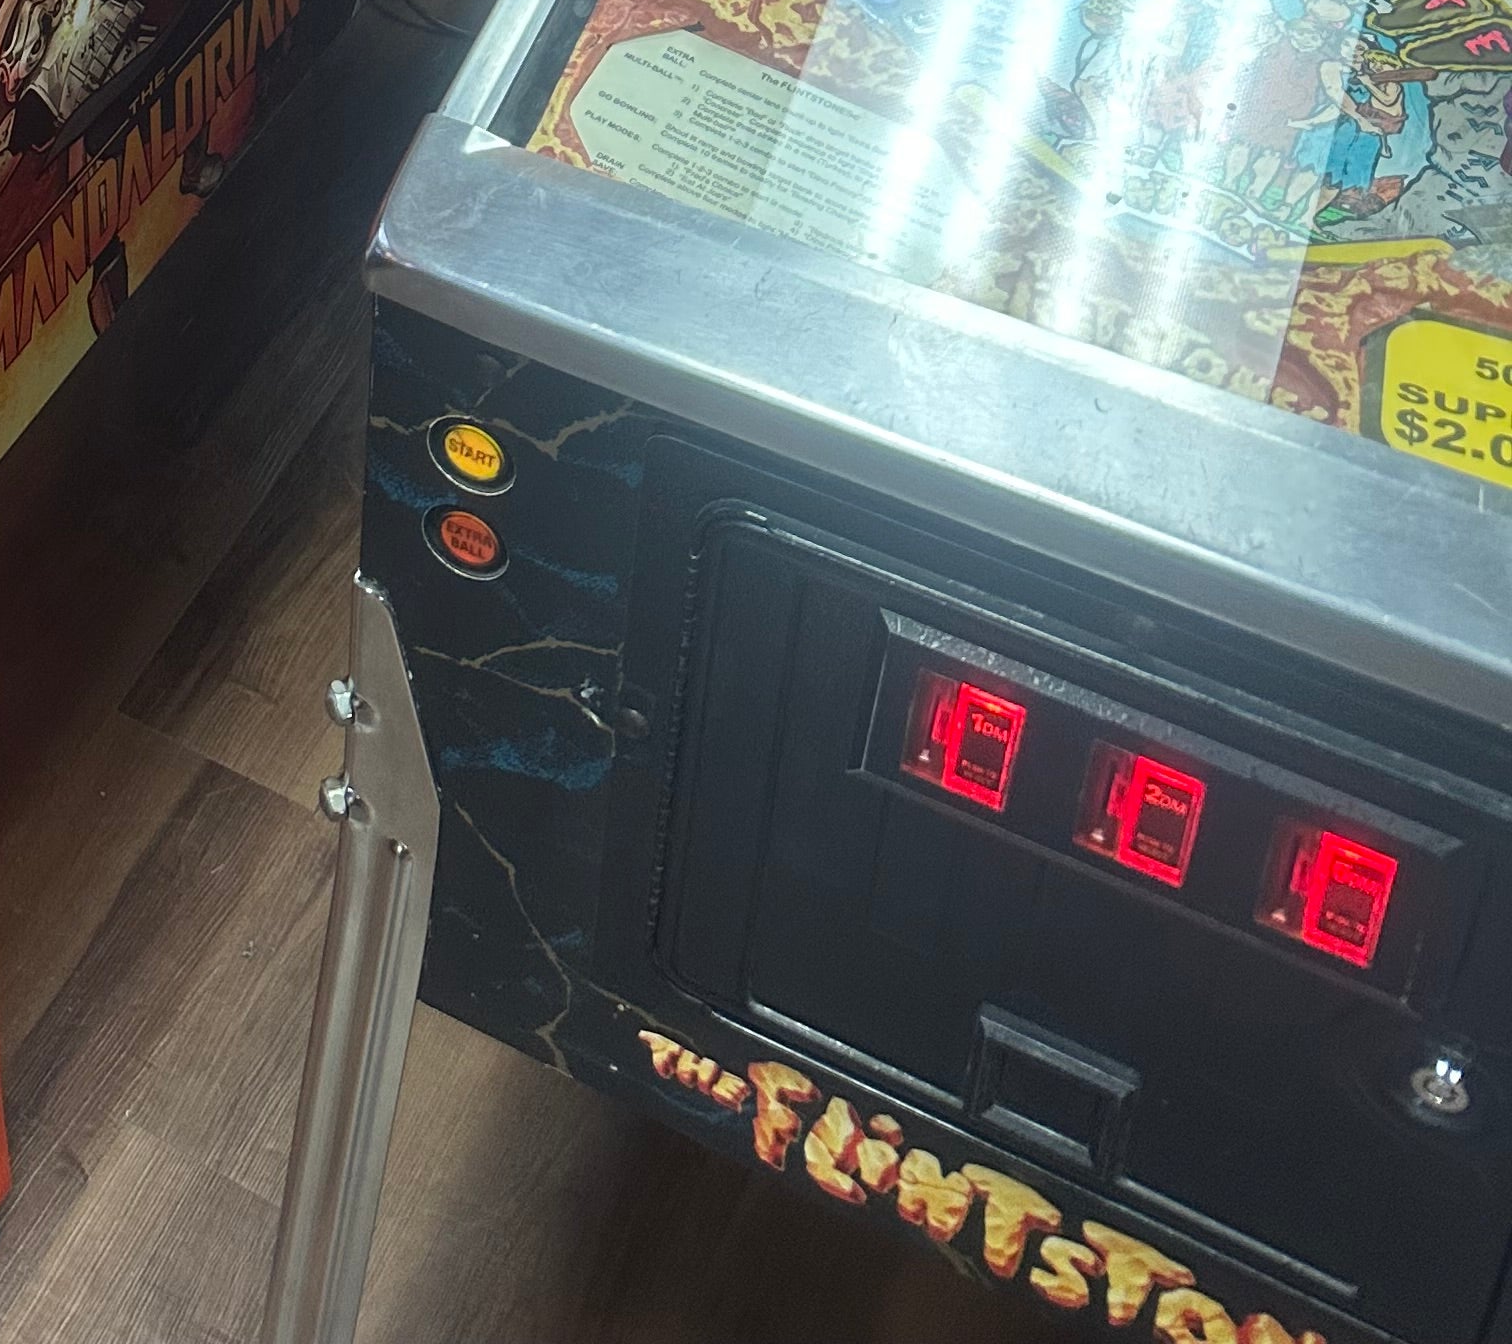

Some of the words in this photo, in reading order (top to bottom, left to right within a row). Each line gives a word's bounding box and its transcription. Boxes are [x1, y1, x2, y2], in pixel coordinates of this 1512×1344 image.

[667, 46, 695, 63] EXTRA
[761, 73, 778, 86] The
[128, 70, 171, 114] THE
[598, 91, 612, 101] GO
[585, 110, 607, 124] PLAY
[597, 152, 624, 169] DRAIN
[720, 149, 735, 160] and
[1396, 382, 1512, 425] SUP
[448, 438, 497, 469] START
[446, 520, 494, 549] EXTRA
[450, 537, 486, 559] BALL
[639, 1029, 752, 1112] THE
